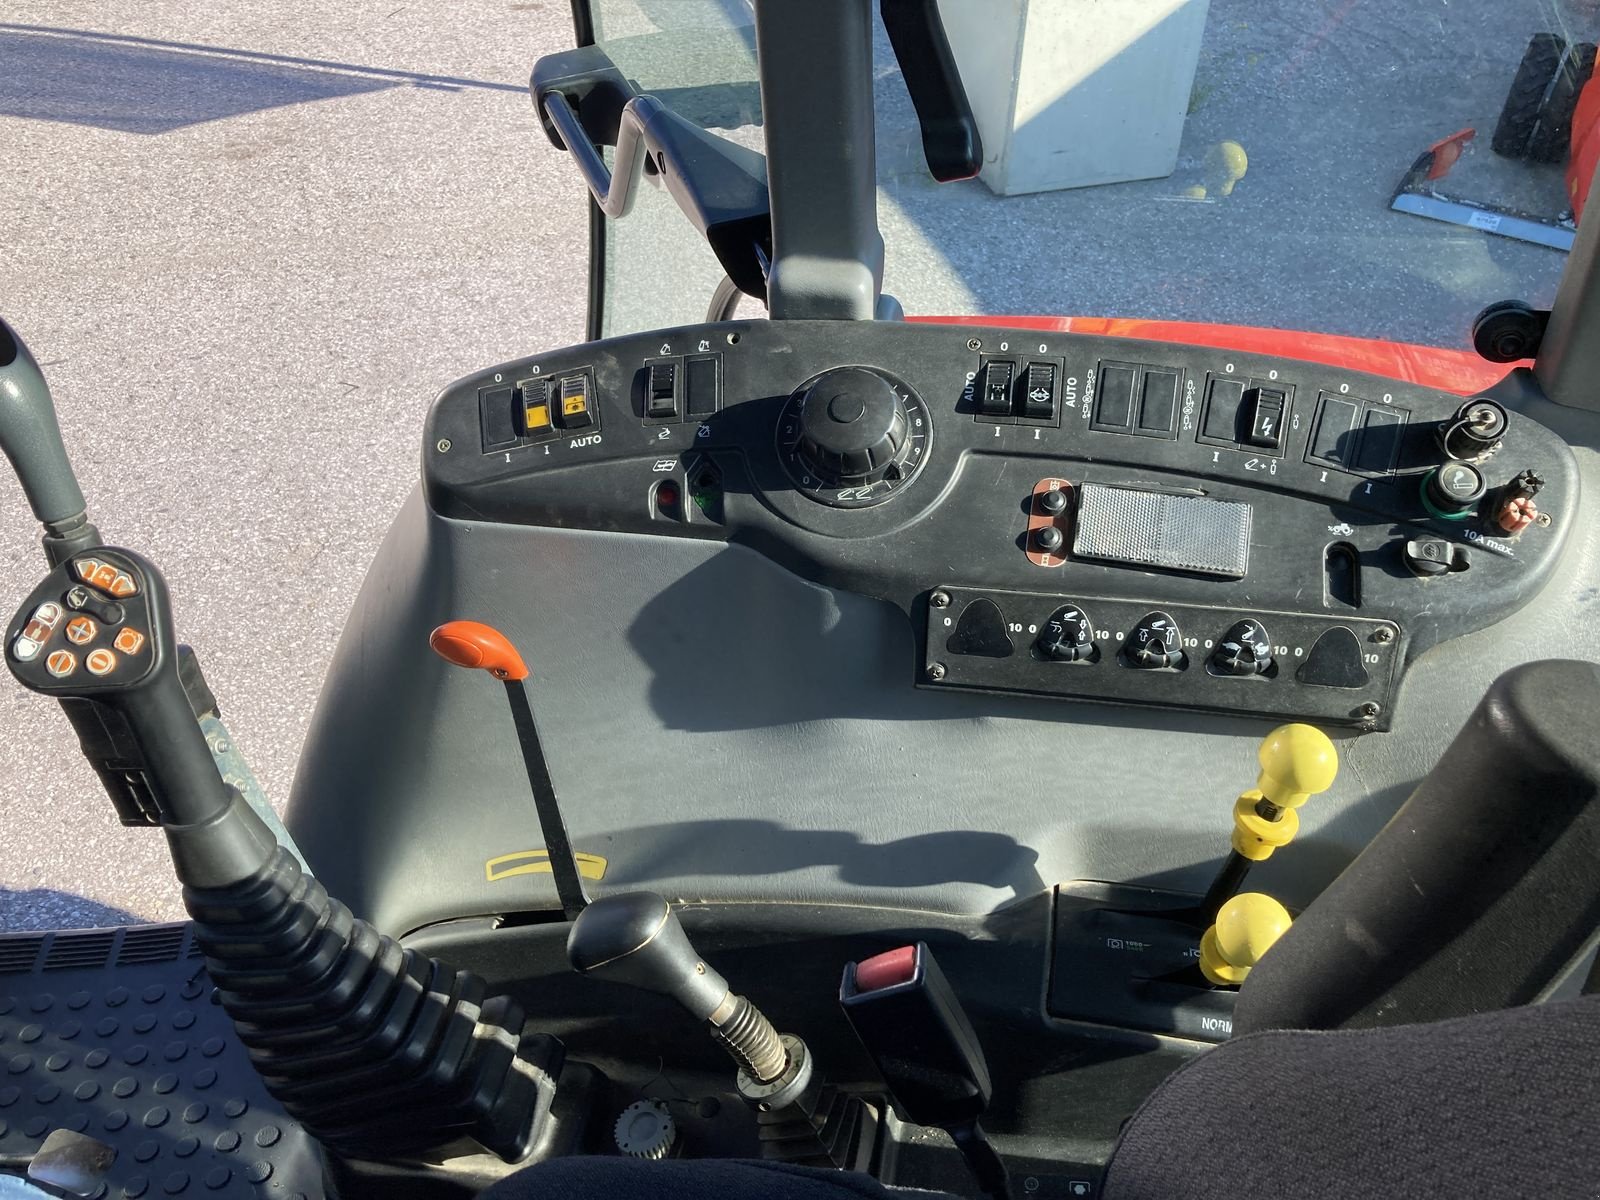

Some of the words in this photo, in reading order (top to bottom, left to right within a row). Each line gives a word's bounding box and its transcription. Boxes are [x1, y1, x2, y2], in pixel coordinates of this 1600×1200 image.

[964, 371, 977, 402] AUTO
[1065, 377, 1078, 408] AUTO
[902, 394, 909, 403] 7
[915, 418, 922, 427] 8
[786, 425, 794, 434] 2
[570, 434, 603, 450] AUTO
[914, 447, 921, 456] 9
[789, 453, 795, 462] 1
[802, 476, 810, 485] 0
[1463, 529, 1485, 544] 10A
[1487, 540, 1515, 556] max.
[943, 617, 952, 627] 0
[1009, 623, 1023, 633] 10
[1028, 624, 1037, 635] 0
[1095, 630, 1110, 640] 10
[1116, 631, 1125, 641] 0
[1183, 638, 1198, 648] 10
[1204, 639, 1213, 649] 0
[1273, 645, 1288, 656] 10
[1294, 647, 1303, 657] 0
[1364, 653, 1379, 664] 10
